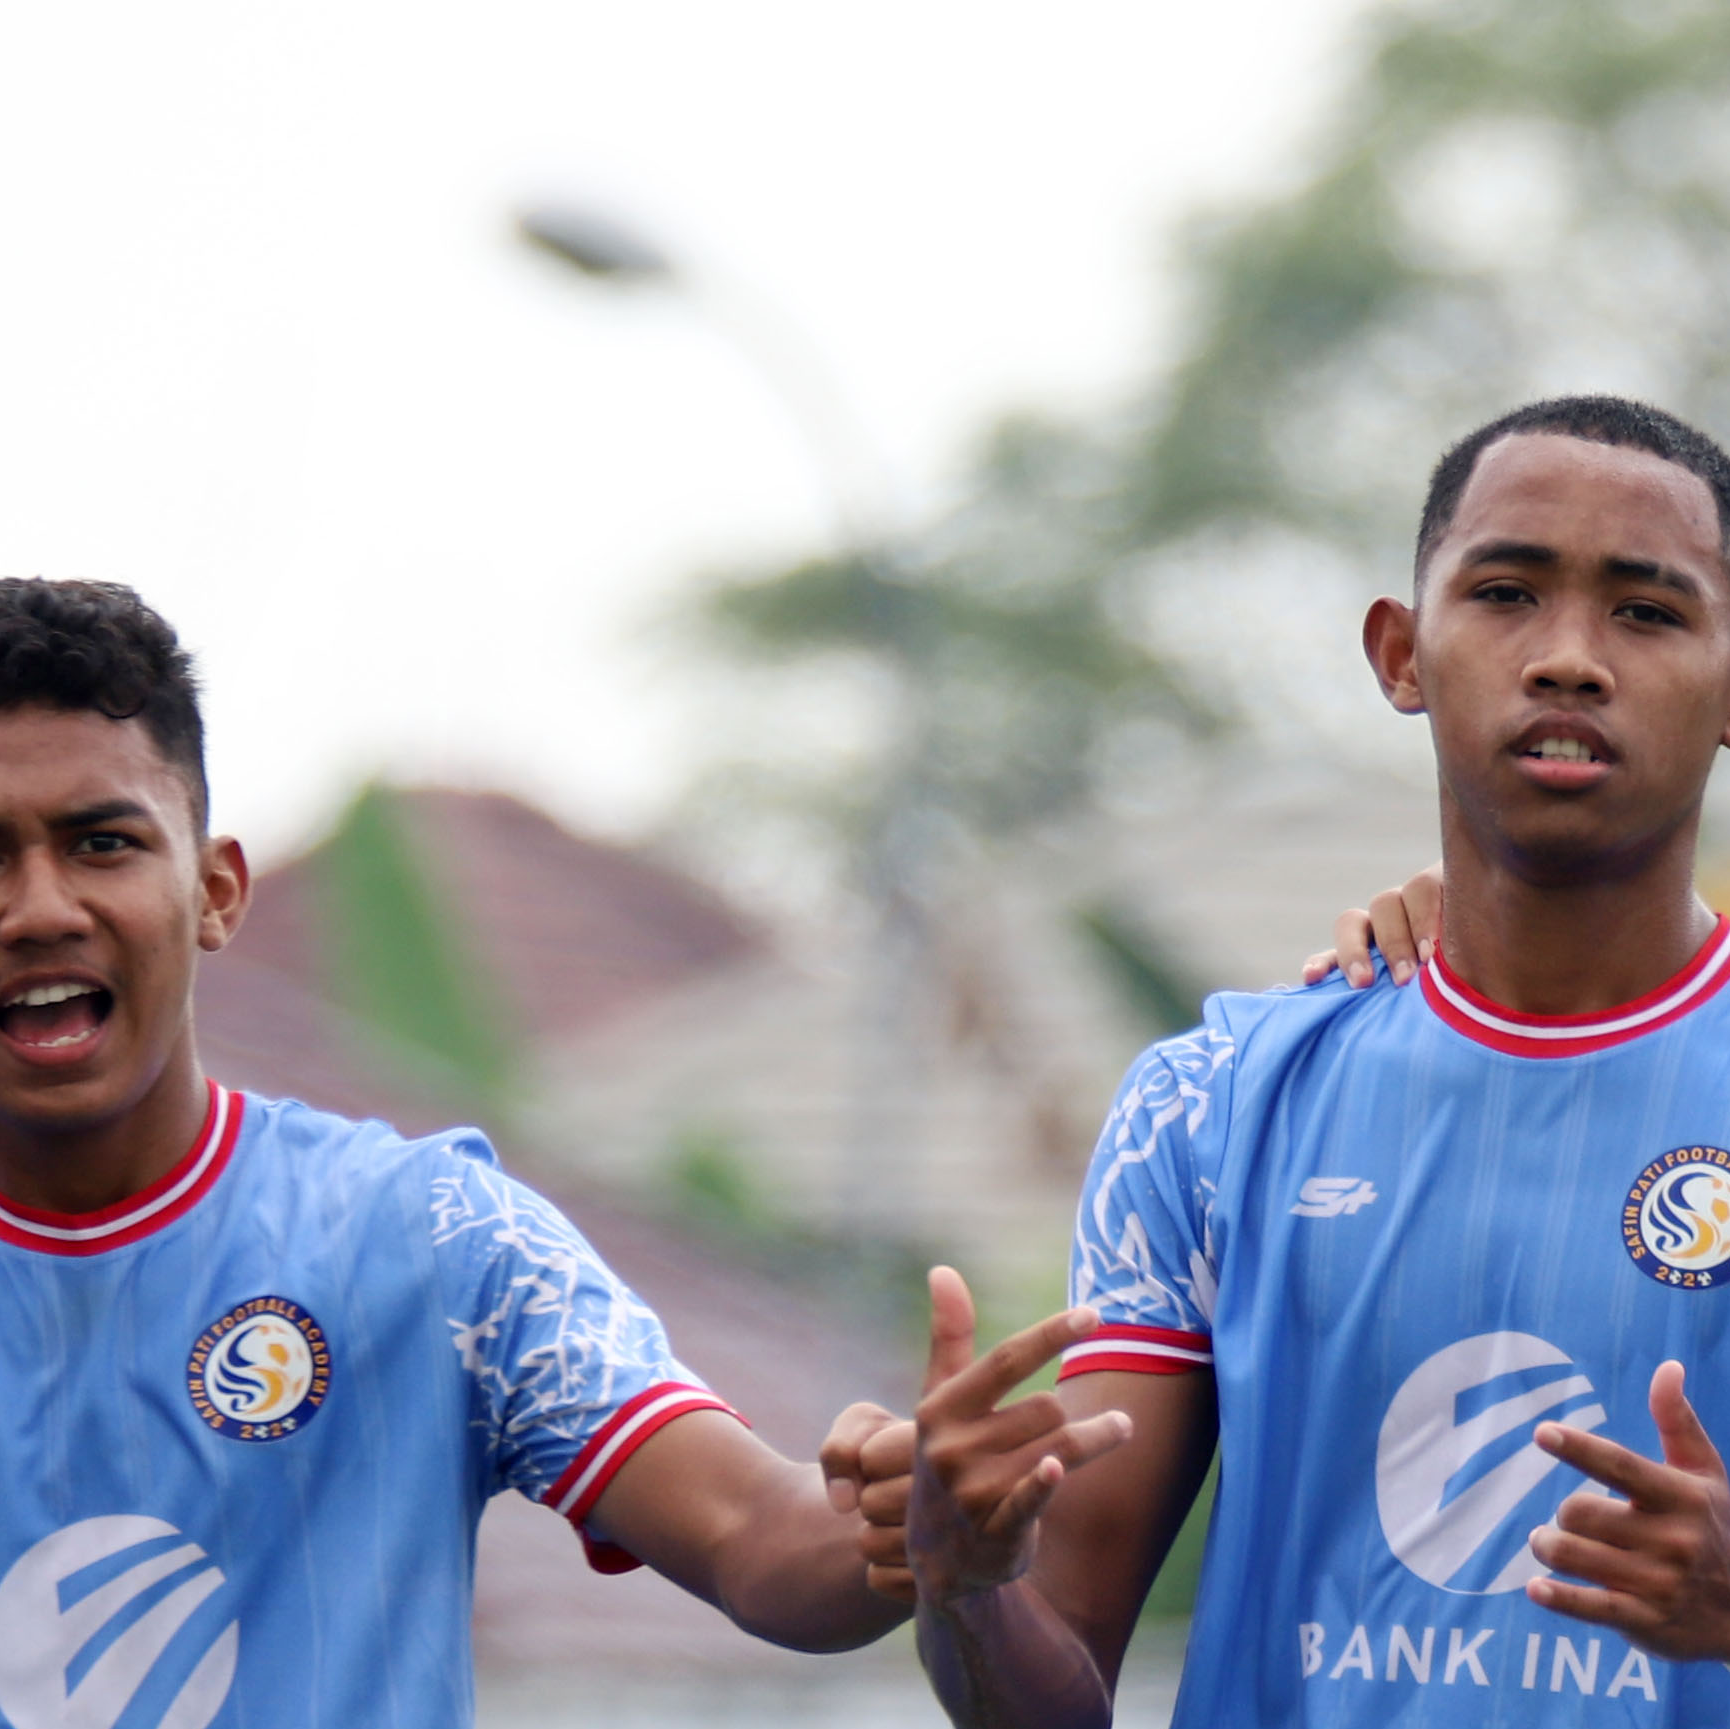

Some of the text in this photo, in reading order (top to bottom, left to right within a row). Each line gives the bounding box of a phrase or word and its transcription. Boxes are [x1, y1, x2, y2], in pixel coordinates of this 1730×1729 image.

[1629, 1162, 1664, 1201] PATI
[1623, 1205, 1647, 1260] SAFIN
[188, 1298, 330, 1429] SAFIN PATI FOOTBALL ACADEMY
[1299, 1622, 1657, 1702] BANK INA
